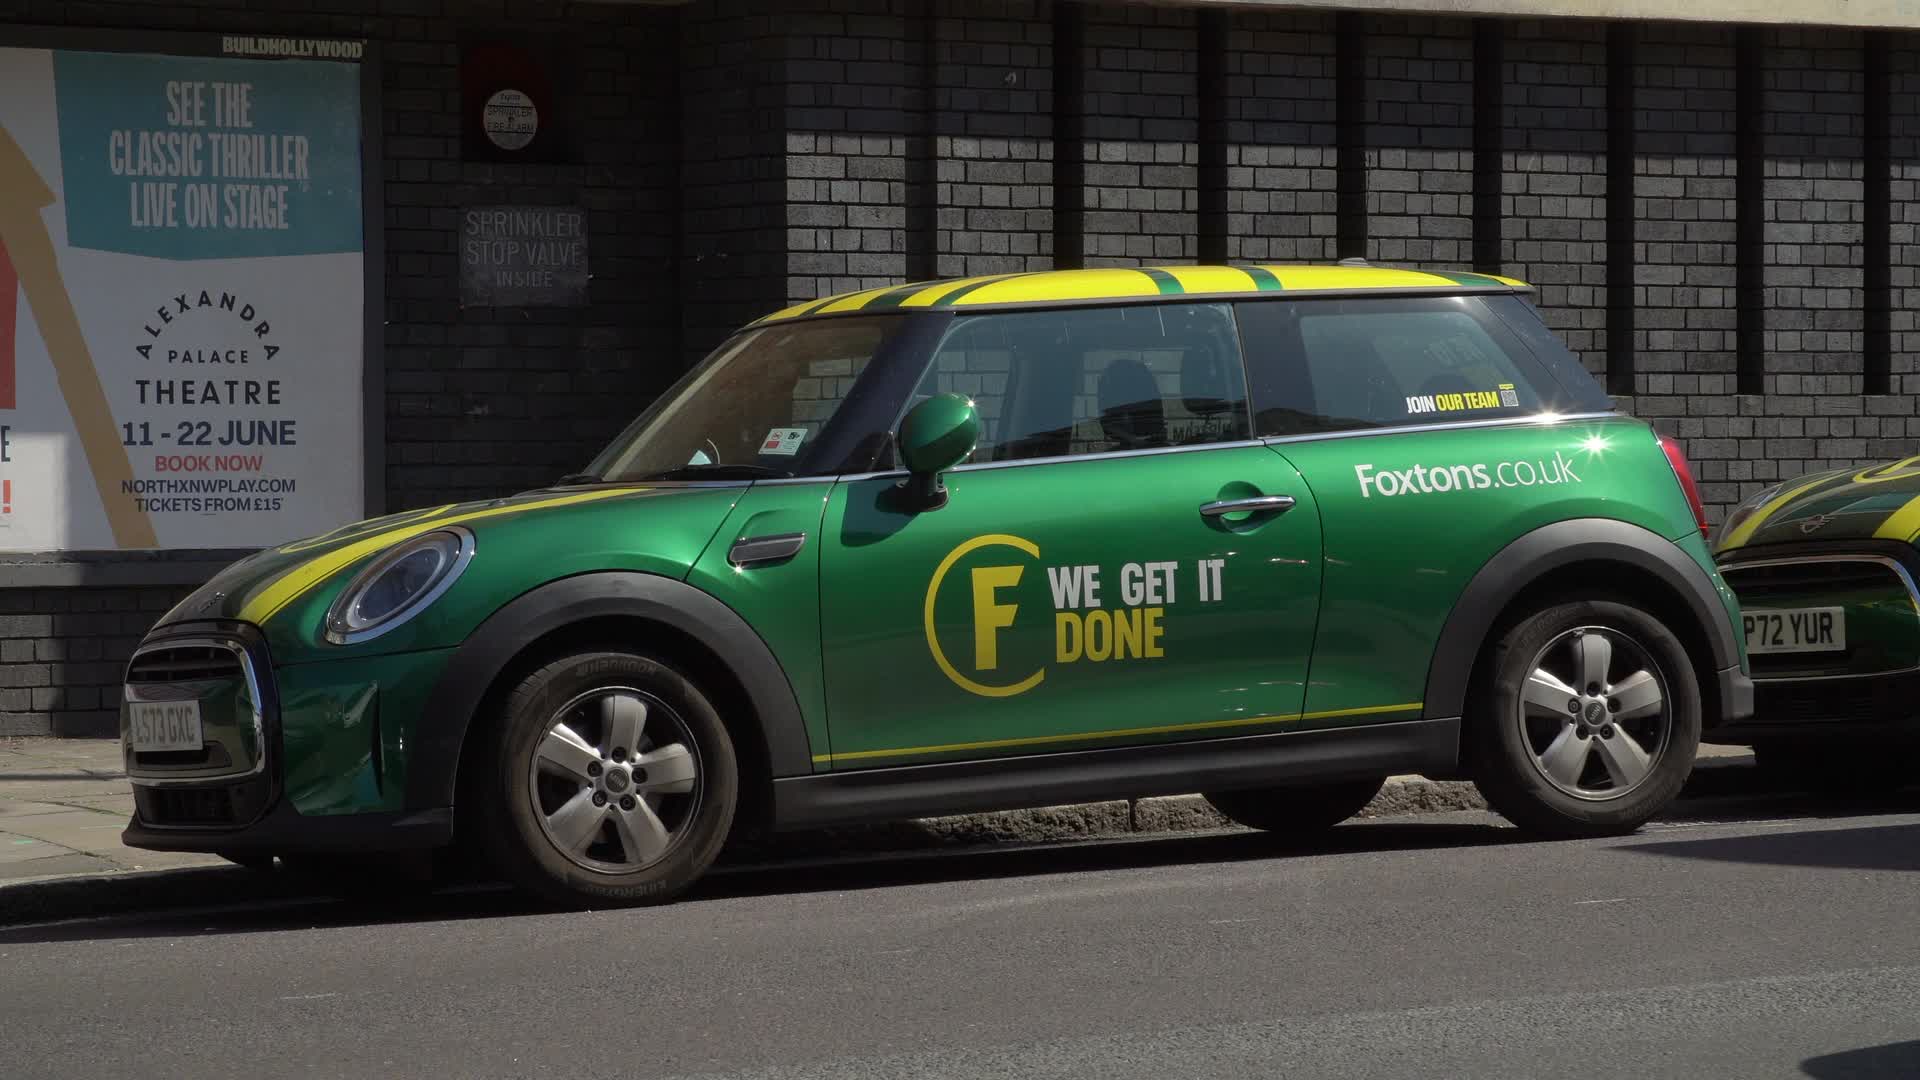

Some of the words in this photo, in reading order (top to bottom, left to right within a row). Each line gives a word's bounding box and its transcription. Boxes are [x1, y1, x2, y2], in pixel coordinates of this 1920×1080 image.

[166, 81, 206, 127] SEE
[211, 82, 253, 128] THE
[109, 130, 202, 177] CLASSIC
[208, 133, 309, 180] THRILLER
[130, 182, 178, 228] LIVE
[184, 183, 218, 228] ON
[223, 185, 289, 230] STAGE
[465, 210, 582, 238] SPRINKLER
[466, 239, 520, 265] STOP
[525, 240, 581, 267] VALVE
[496, 270, 553, 288] INSIDE
[135, 290, 280, 360] ALEXANDRA
[168, 350, 249, 364] PALACE
[135, 380, 281, 405] THEATRE
[1405, 395, 1436, 414] JOIN
[1436, 393, 1463, 412] OUR
[1463, 391, 1500, 409] TEAM
[123, 422, 154, 446] 11
[177, 421, 213, 446] 22
[218, 420, 296, 446] JUNE
[155, 455, 210, 472] BOOK
[214, 455, 263, 472] NOW
[1354, 451, 1582, 498] Foxtons.co.uk
[121, 479, 296, 494] NORTHXNWPLAY.COM
[135, 497, 202, 513] TICKETS
[205, 497, 251, 512] FROM
[1047, 565, 1101, 609] WE
[1120, 560, 1179, 606] GET
[1198, 558, 1225, 602] IT
[1056, 607, 1165, 663] DONE
[1790, 612, 1833, 645] YUR
[134, 707, 166, 745] LS73
[167, 706, 194, 745] GXC
